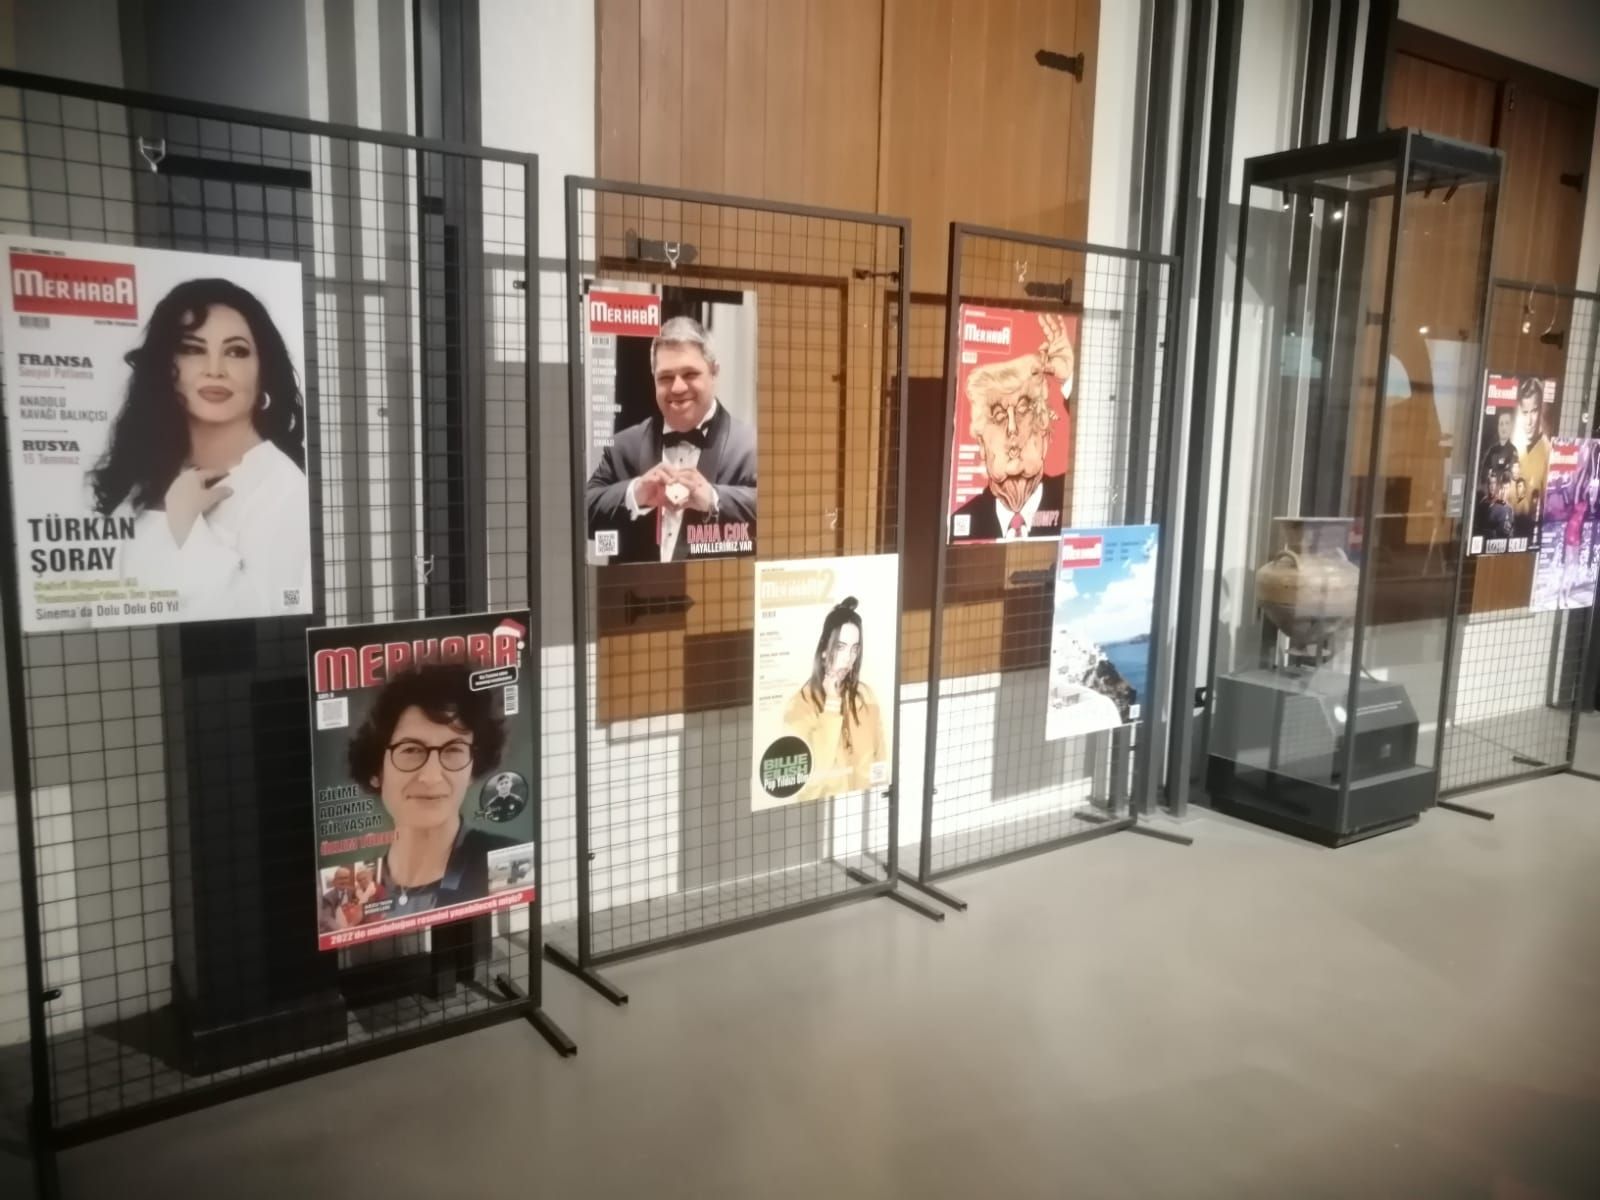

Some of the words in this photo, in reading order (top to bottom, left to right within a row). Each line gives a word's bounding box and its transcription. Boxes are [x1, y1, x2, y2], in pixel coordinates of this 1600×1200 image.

[13, 268, 135, 305] MERHABA
[590, 301, 659, 326] MERHABA
[18, 353, 93, 368] FRANSA
[20, 396, 66, 407] ANADOLU
[22, 440, 80, 452] RUSYA
[27, 514, 136, 542] TÜRKAN
[687, 523, 721, 544] DAHA
[739, 540, 753, 552] VAR
[30, 547, 116, 578] ŞORAY
[97, 604, 121, 617] Dolu
[123, 602, 147, 615] Dolu
[150, 601, 164, 613] 60
